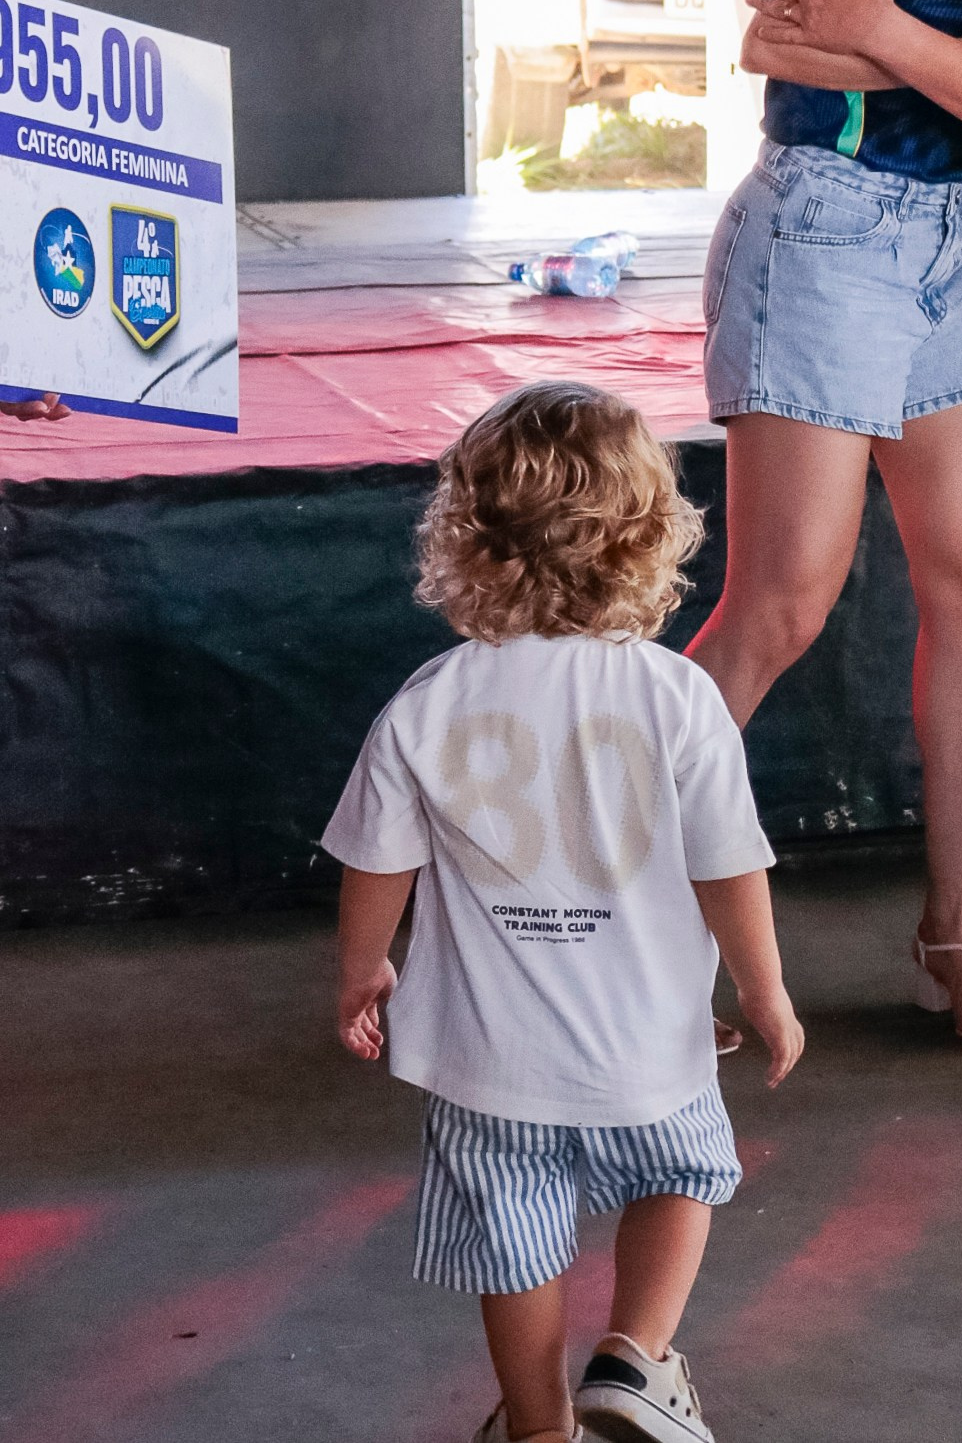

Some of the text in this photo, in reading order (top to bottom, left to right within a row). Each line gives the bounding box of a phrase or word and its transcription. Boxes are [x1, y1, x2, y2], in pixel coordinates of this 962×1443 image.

[17, 126, 189, 188] CATEGORIA FEMININA
[123, 257, 171, 276] CAMPEONATO
[52, 288, 80, 308] IRAD
[122, 274, 172, 313] PESCA
[438, 712, 661, 894] 80
[492, 905, 612, 920] CONSTANT MOTION
[504, 920, 596, 933] TRAINING CLUB
[516, 934, 535, 942] Game
[542, 936, 570, 945] Progress
